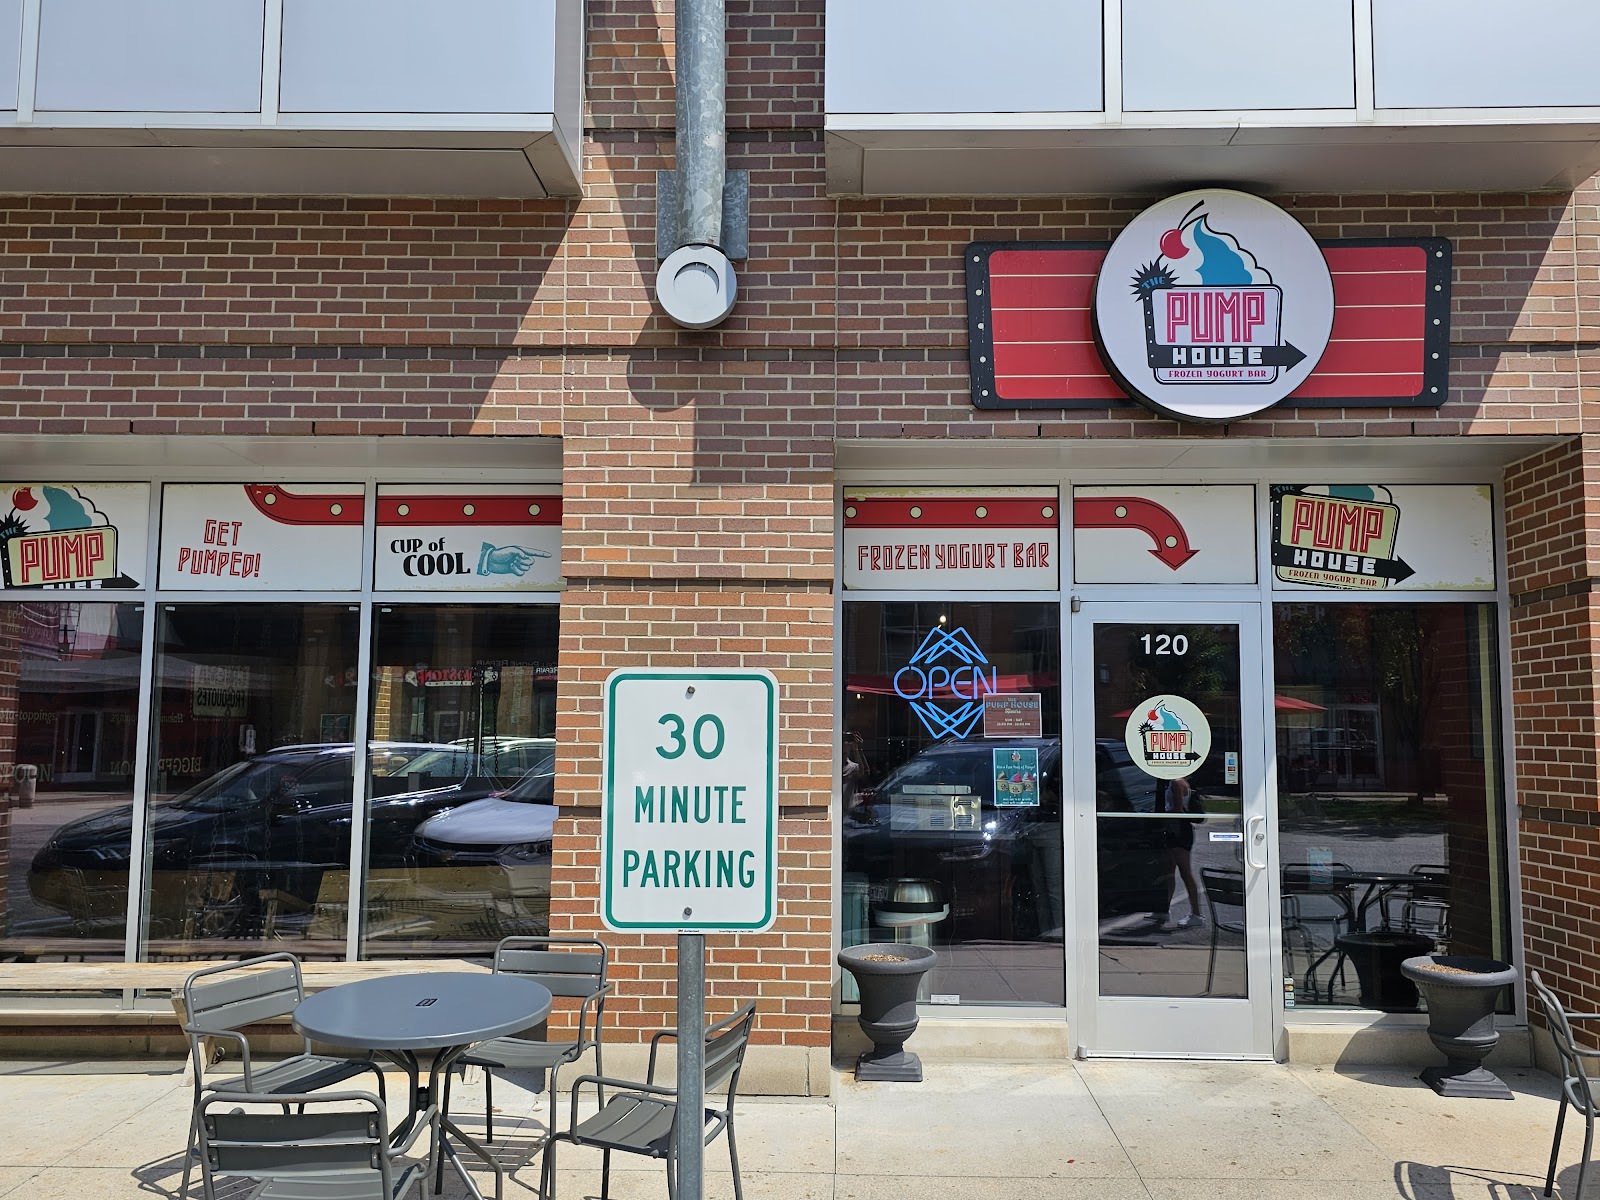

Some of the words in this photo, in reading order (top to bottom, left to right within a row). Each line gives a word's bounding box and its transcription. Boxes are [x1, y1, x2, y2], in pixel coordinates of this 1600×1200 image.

[1141, 276, 1166, 290] THE
[1166, 291, 1265, 343] PUMP
[1172, 347, 1263, 365] HOUSE
[1168, 370, 1203, 378] FROZEN
[1206, 370, 1244, 378] YOGURT
[1248, 370, 1267, 378] BAR
[0, 525, 19, 540] THE
[203, 519, 243, 547] GET
[1291, 498, 1385, 554] PUMP
[390, 538, 424, 554] CUP
[428, 536, 446, 552] of
[858, 545, 931, 571] FROZEN
[935, 543, 1008, 570] YOGURT
[1013, 542, 1050, 568] BAR
[20, 532, 105, 584] PUMP
[178, 547, 261, 579] PUMPED!
[403, 552, 471, 577] COOL
[1293, 549, 1377, 575] HOUSE
[1288, 569, 1320, 580] FROZEN
[1323, 573, 1357, 584] YOGURT
[1360, 578, 1378, 587] BAR
[1140, 633, 1189, 656] 120
[893, 665, 997, 700] OPEN
[986, 701, 1009, 709] PUMP
[1010, 701, 1039, 709] HOUSE
[655, 713, 726, 760] 30
[1151, 732, 1187, 752] PUMP
[1152, 752, 1187, 760] HOUSE
[634, 785, 747, 824] MINUTE
[622, 850, 755, 889] PARKING
